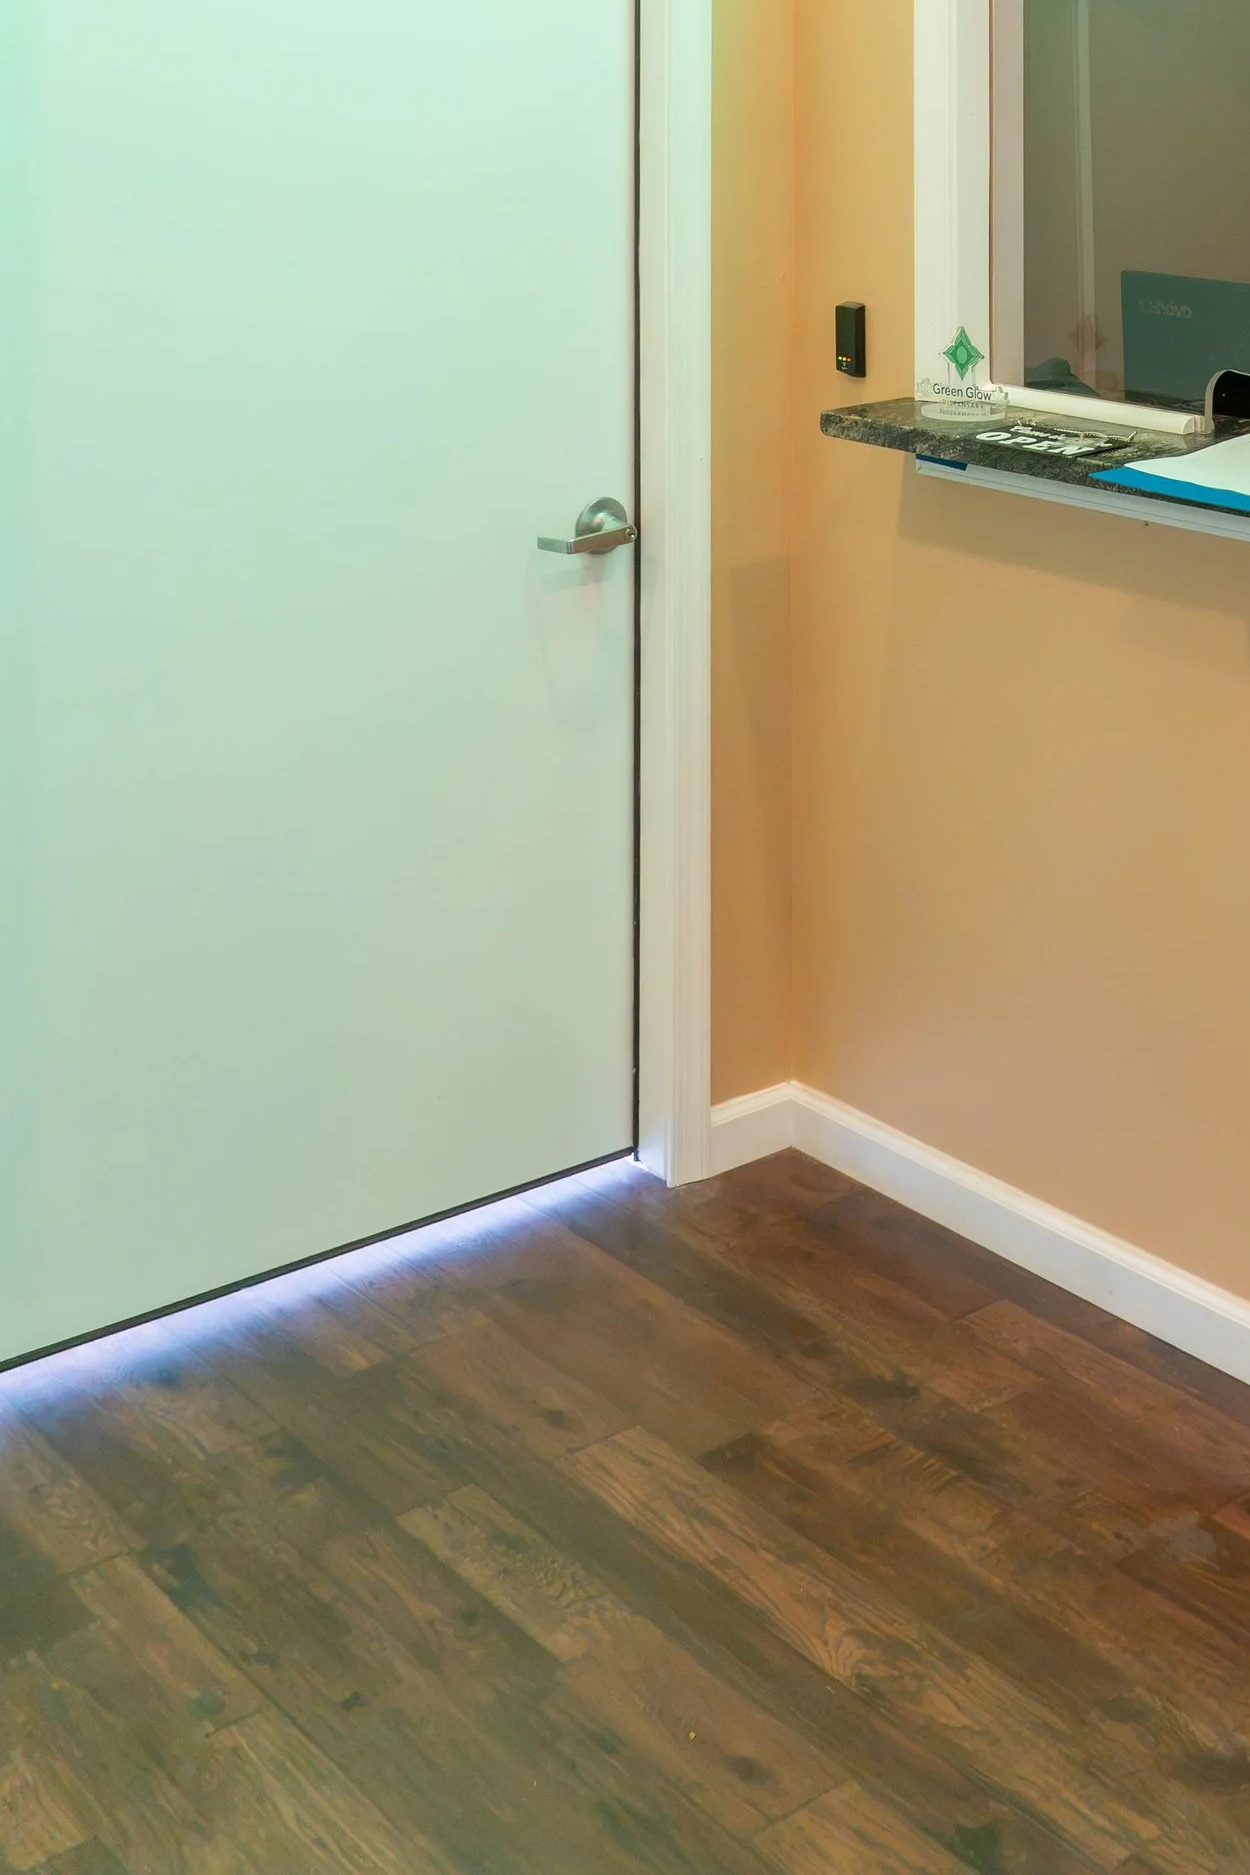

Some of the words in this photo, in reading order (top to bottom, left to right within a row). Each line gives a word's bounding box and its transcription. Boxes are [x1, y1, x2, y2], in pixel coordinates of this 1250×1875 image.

[932, 383, 963, 397] Green
[965, 387, 992, 401] Glow
[975, 431, 1095, 455] OPEN
